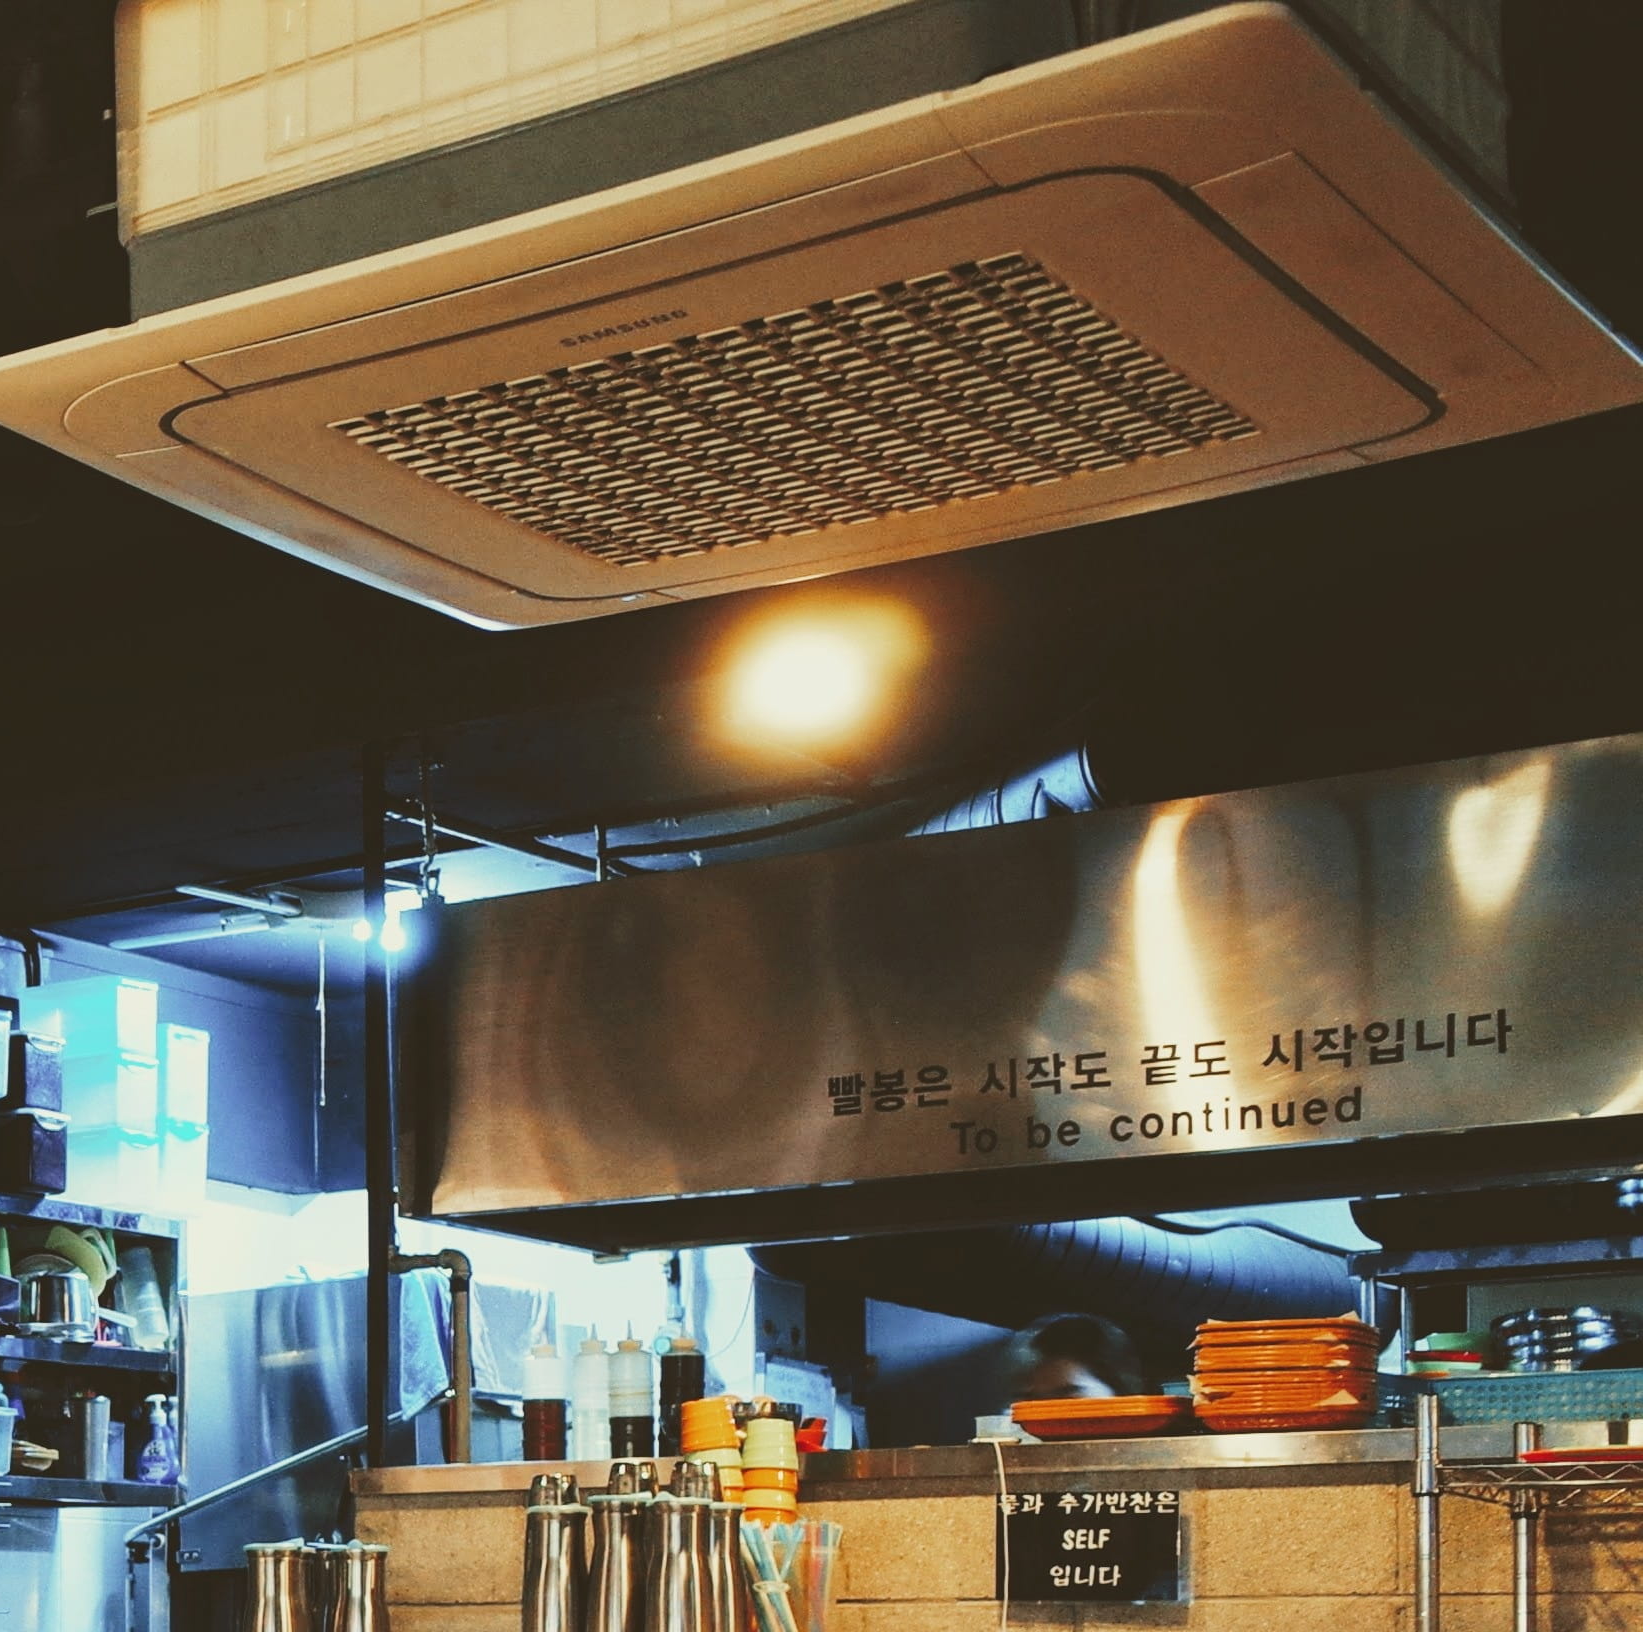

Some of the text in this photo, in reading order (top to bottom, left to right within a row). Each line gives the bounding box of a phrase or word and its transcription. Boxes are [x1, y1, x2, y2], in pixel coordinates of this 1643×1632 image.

[559, 309, 688, 347] SAMSUNG
[828, 1008, 1513, 1116] 빨봉은 시작도 끝도 시작입니다
[949, 1086, 1363, 1154] To be continued
[1057, 1491, 1179, 1514] 추가반찬은
[1062, 1528, 1111, 1550] SELF
[1050, 1565, 1121, 1587] 입니다
